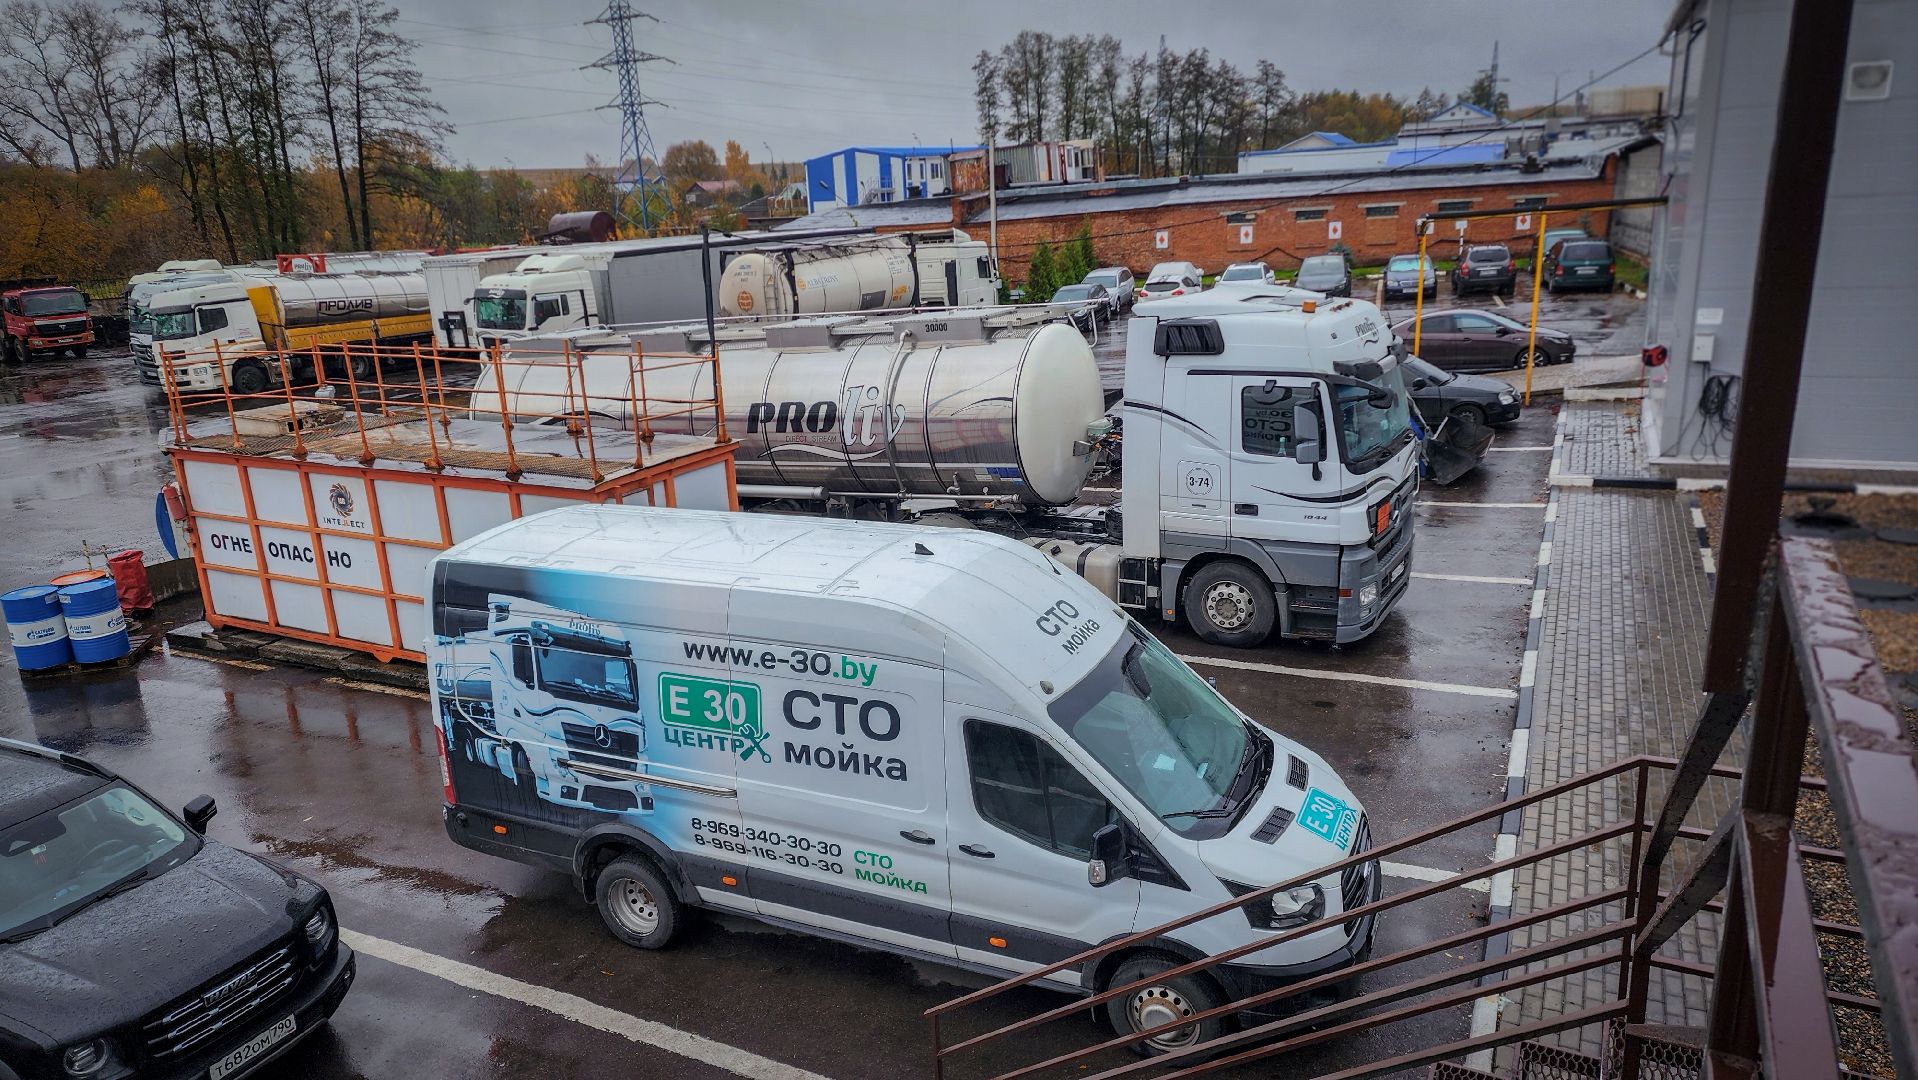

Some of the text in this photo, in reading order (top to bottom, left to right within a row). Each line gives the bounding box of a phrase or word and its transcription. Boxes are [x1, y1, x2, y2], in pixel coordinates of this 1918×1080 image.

[318, 298, 373, 311] ПРОЛИВ
[925, 322, 948, 333] 30000
[1189, 477, 1210, 488] 3-74
[210, 533, 352, 569] ОГНЕ ОПАС НО
[1036, 599, 1079, 637] СТО
[1061, 619, 1101, 655] мойка
[683, 641, 878, 687] www.e-30.by
[703, 689, 747, 726] 30
[782, 689, 901, 742] СТО
[664, 727, 745, 753] ЦЕНТР
[783, 741, 908, 782] мойка
[1311, 796, 1336, 820] 30
[691, 817, 842, 858] 8-969-340-30-30
[694, 833, 844, 875] 8-969-116-30-30
[853, 849, 893, 870] СТО
[855, 867, 928, 895] МОЙКА
